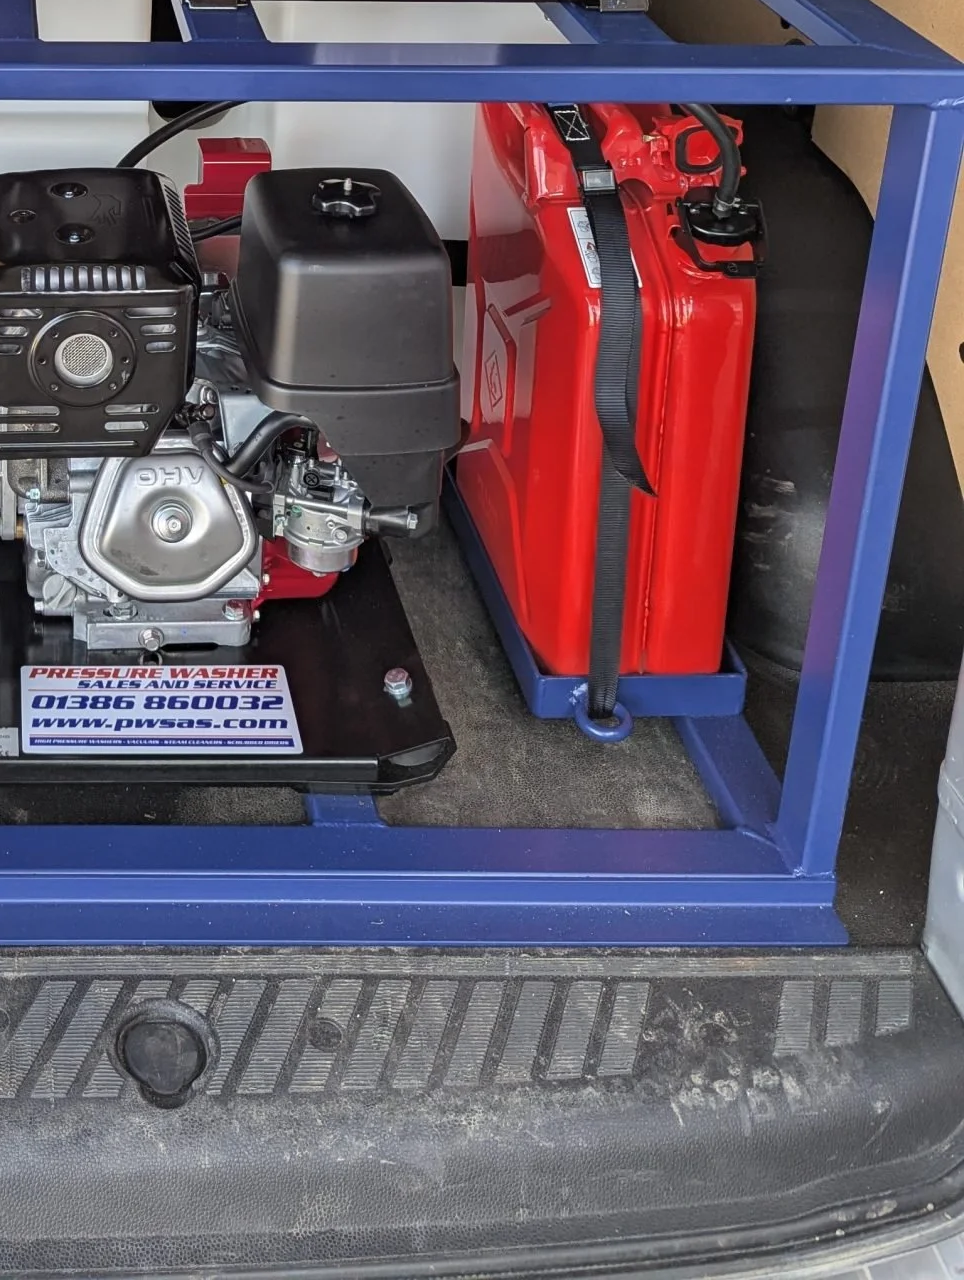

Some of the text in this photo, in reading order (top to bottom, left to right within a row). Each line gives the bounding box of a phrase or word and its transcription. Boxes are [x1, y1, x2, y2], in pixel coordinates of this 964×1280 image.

[136, 465, 204, 486] OHV
[29, 667, 278, 679] PRESSURE WASHER
[77, 679, 277, 689] SALES AND SERVICE
[31, 695, 284, 710] 01386 860032
[31, 718, 288, 732] www.pwsas.com
